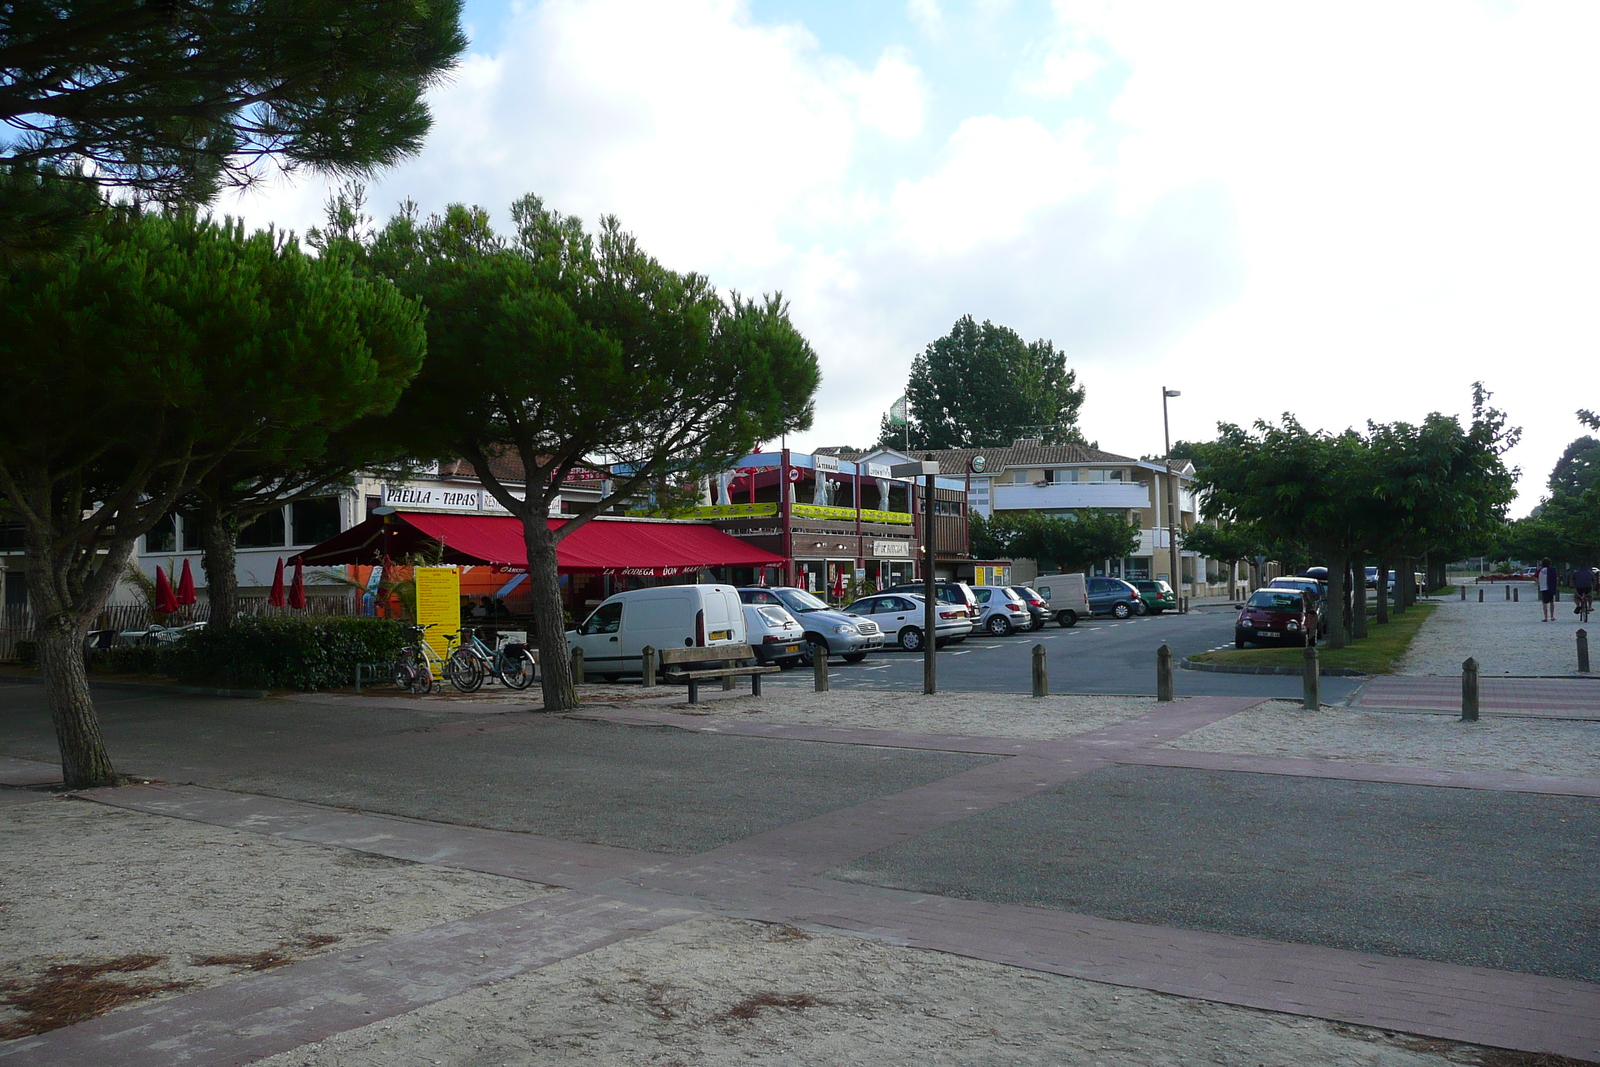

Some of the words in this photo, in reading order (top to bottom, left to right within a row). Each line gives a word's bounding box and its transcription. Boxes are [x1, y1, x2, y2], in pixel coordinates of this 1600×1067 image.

[443, 492, 476, 506] TAPAS
[622, 568, 655, 576] BODEGA
[662, 567, 678, 575] DON
